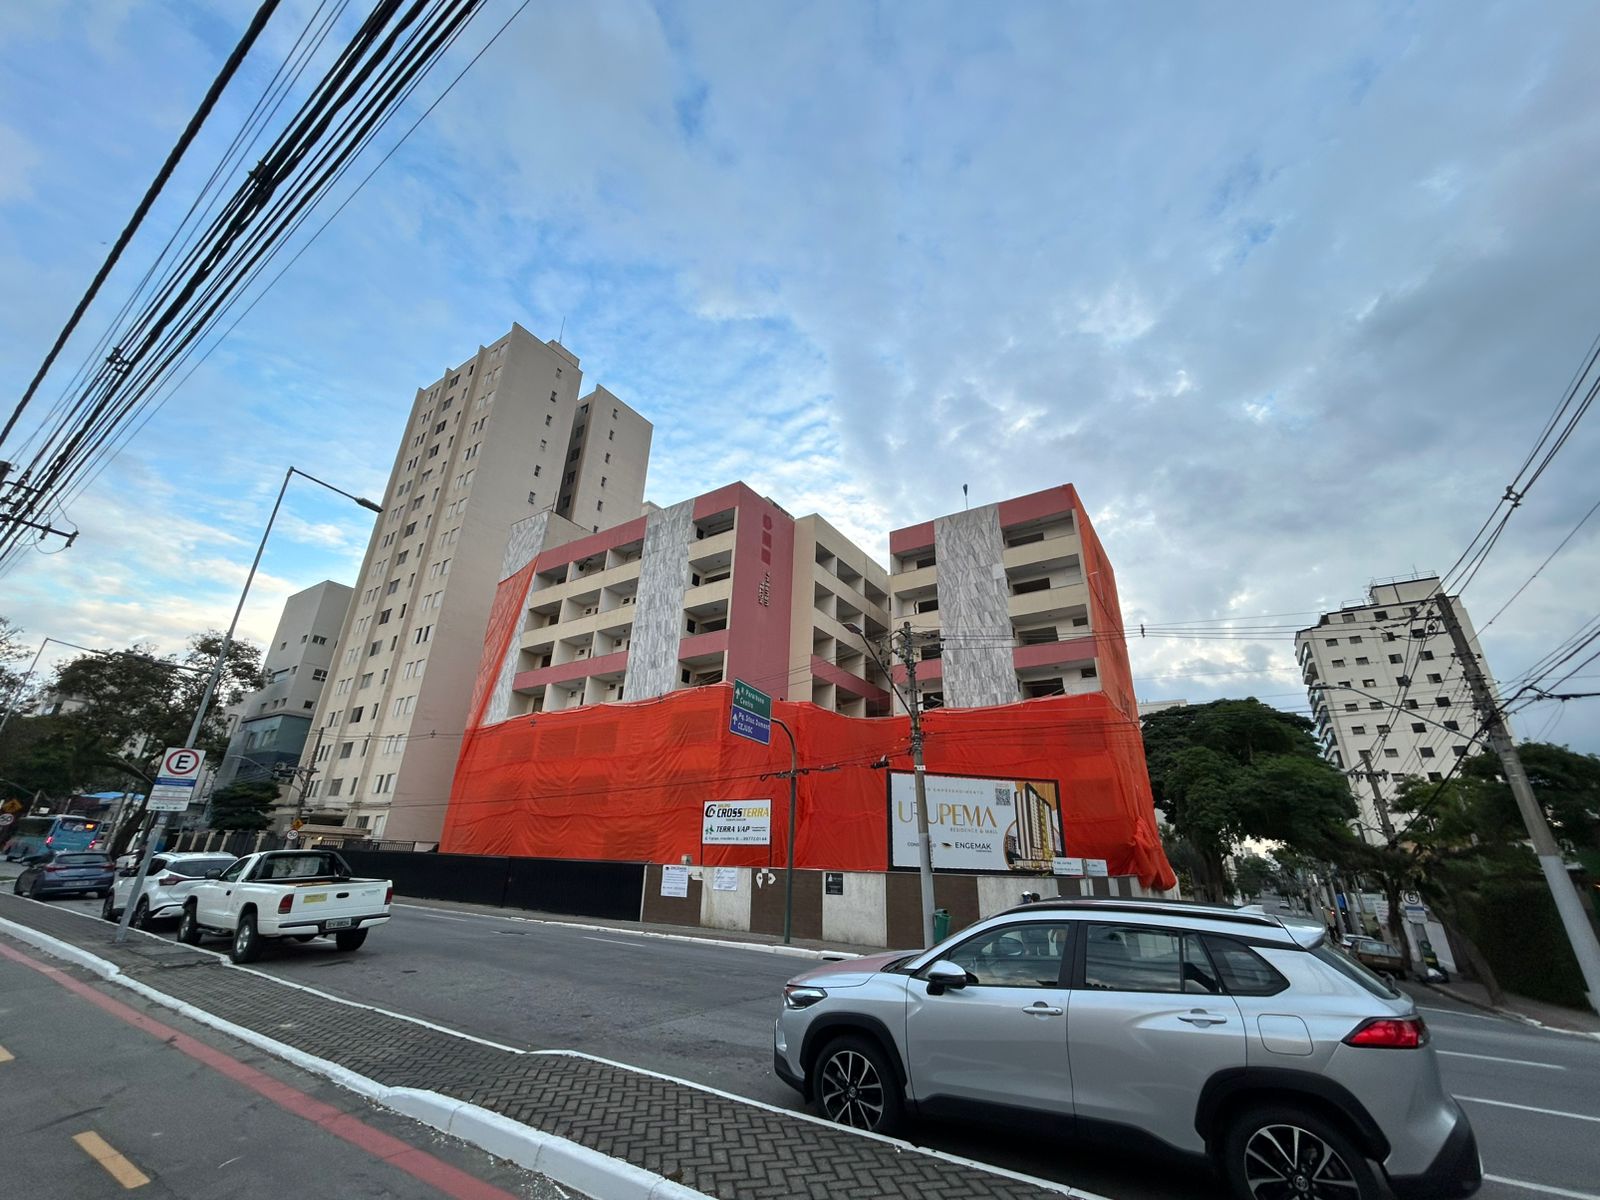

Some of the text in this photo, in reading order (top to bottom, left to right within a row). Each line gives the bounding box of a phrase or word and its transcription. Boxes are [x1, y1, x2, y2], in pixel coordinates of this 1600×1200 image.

[175, 755, 191, 769] E
[716, 825, 735, 833] TERRA
[737, 825, 750, 833] VAP
[955, 841, 992, 850] ENGEMAK
